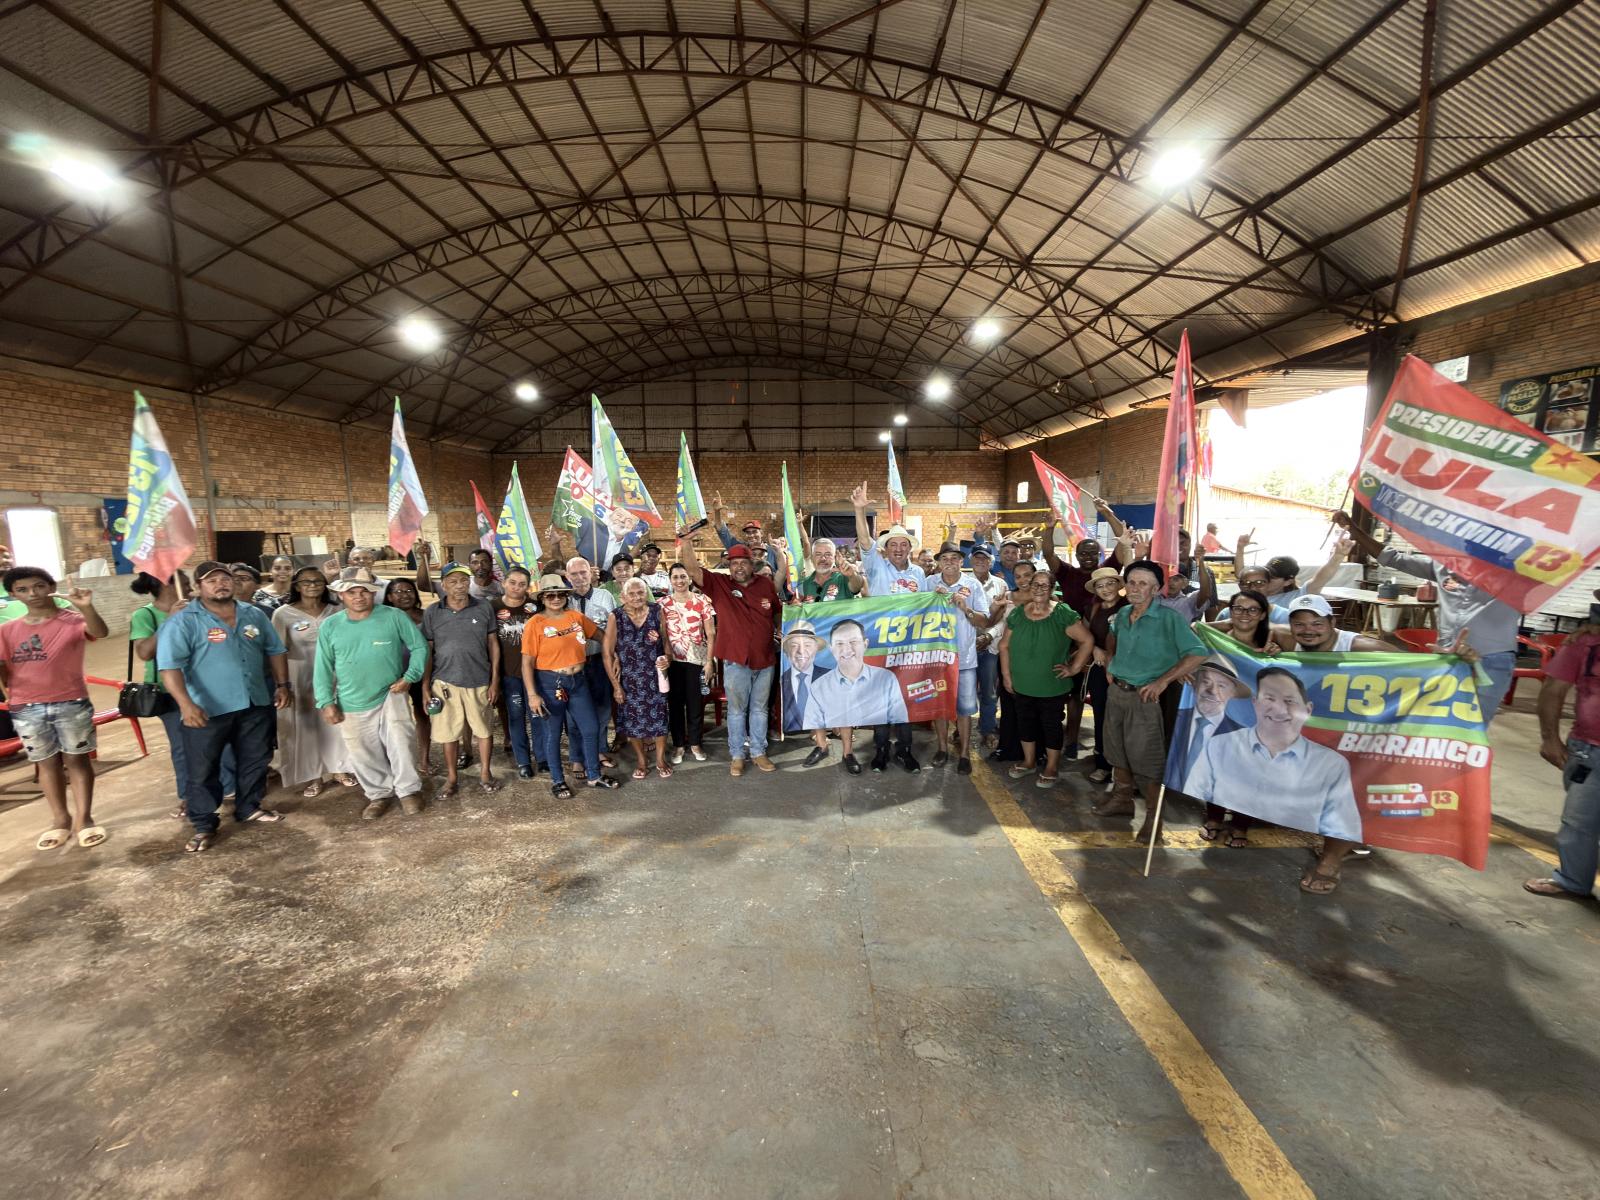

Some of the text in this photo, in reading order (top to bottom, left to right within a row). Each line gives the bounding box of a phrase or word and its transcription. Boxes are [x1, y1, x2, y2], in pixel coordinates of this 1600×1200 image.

[1388, 402, 1541, 459] PRESIDENTE
[1368, 434, 1583, 535] LULA
[496, 505, 525, 569] 1312
[1398, 498, 1525, 554] ALCKMIN
[1522, 545, 1572, 573] 13
[874, 612, 956, 643] 13123
[885, 649, 956, 668] BARRANCO
[1321, 673, 1484, 723] 13123
[1337, 732, 1490, 768] BARRANCO
[1367, 792, 1452, 805] LULA 13
